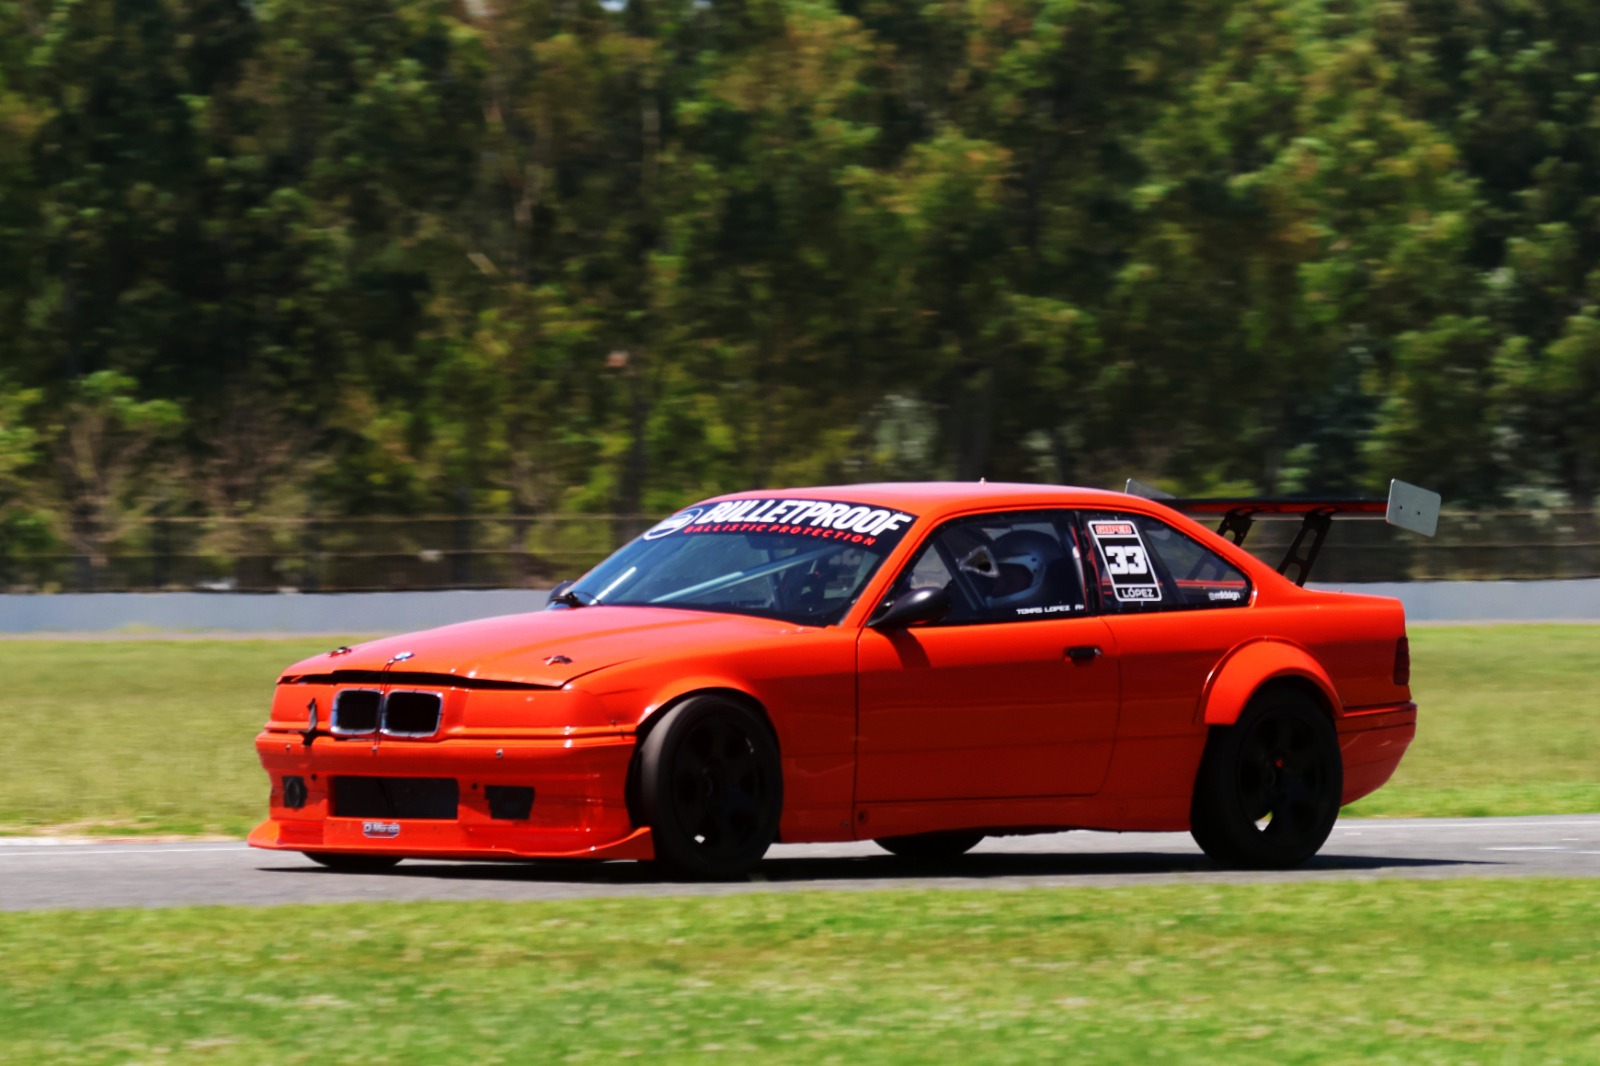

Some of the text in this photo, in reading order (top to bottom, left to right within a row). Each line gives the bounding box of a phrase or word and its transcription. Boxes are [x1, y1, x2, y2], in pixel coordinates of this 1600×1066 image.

[694, 499, 913, 536] BULLETPROOF
[683, 523, 877, 546] BALLISTIC PROTECTION
[1105, 545, 1148, 575] 33
[1121, 587, 1155, 598] LÓPEZ
[1016, 606, 1043, 615] TOMAS
[1044, 604, 1071, 613] LOPEZ
